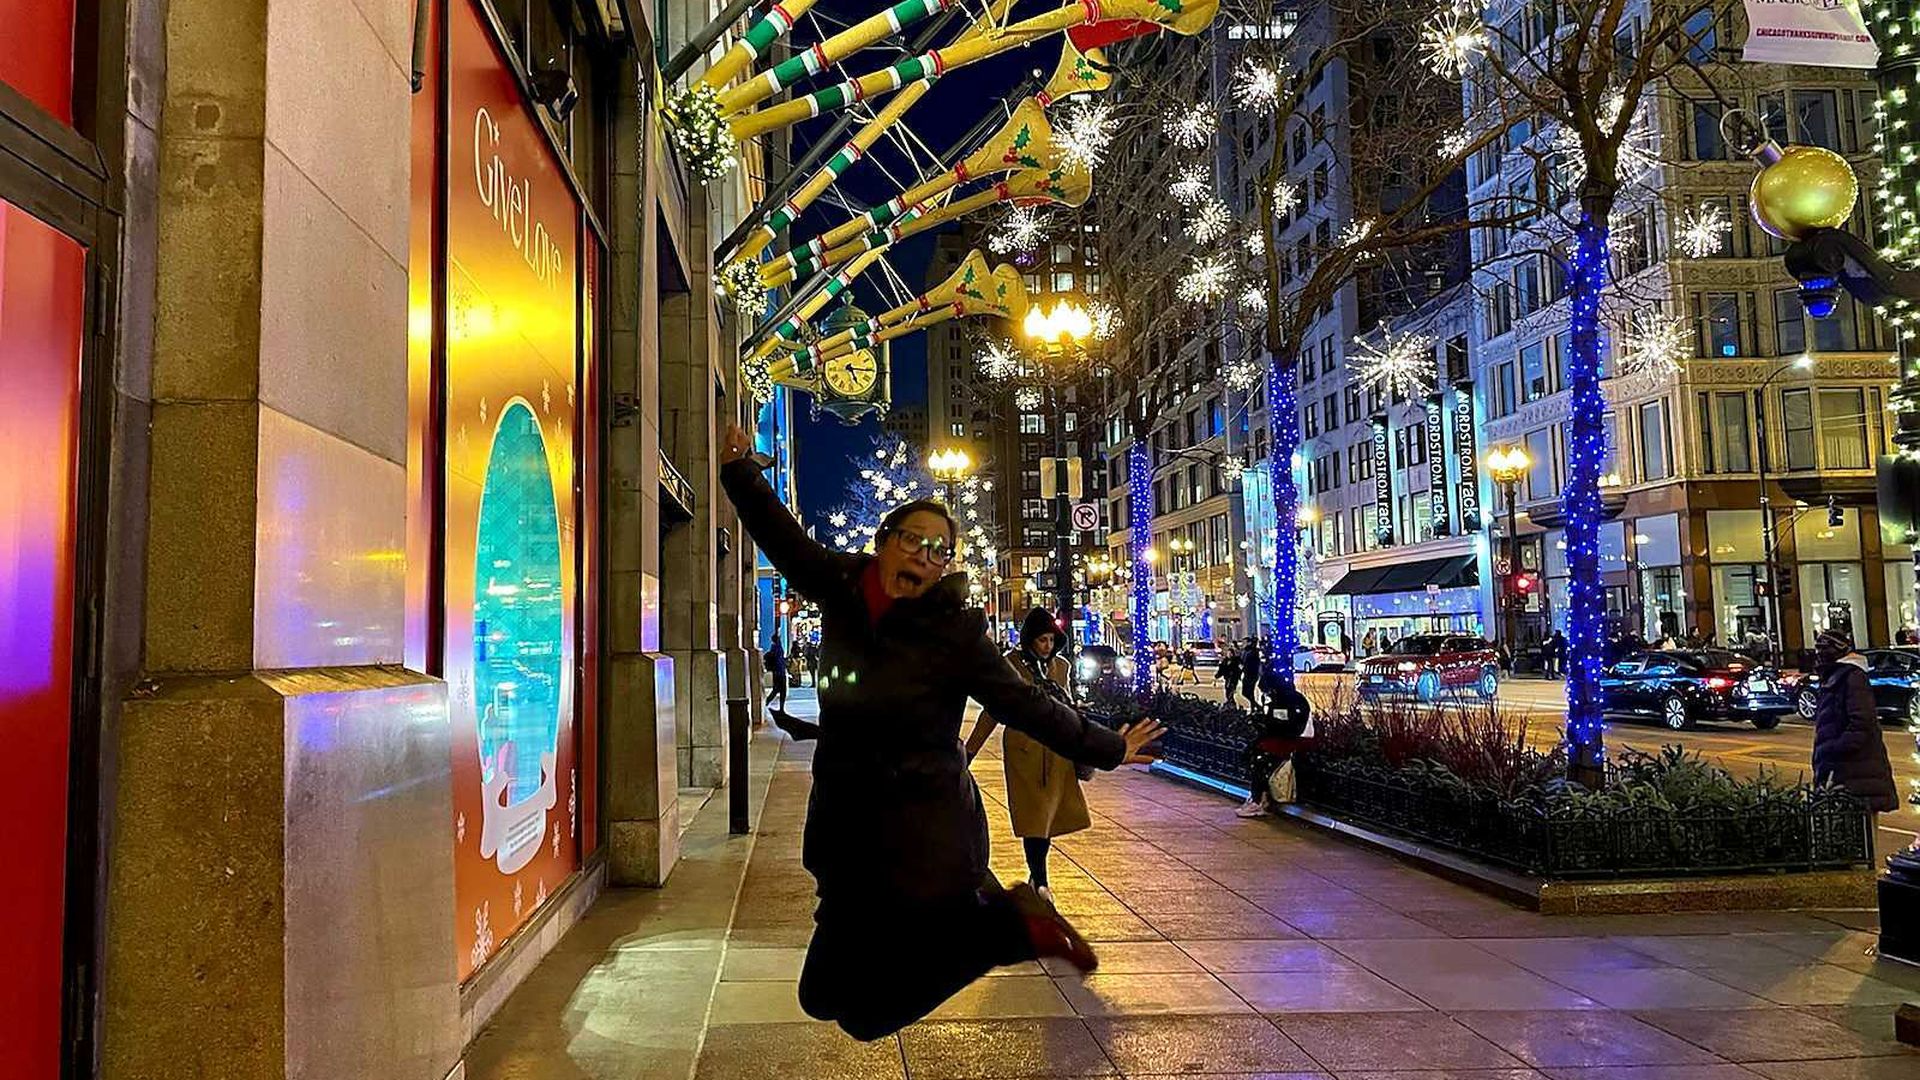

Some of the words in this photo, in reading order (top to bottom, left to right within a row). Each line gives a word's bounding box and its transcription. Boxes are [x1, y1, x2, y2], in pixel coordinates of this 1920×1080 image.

[1372, 423, 1388, 499] NORDSTROM
[1427, 402, 1443, 487] NORDSTROM
[1456, 390, 1473, 478] NORDSTROM
[1378, 502, 1392, 535] rack
[1432, 489, 1447, 523] rack
[1462, 480, 1479, 518] rack
